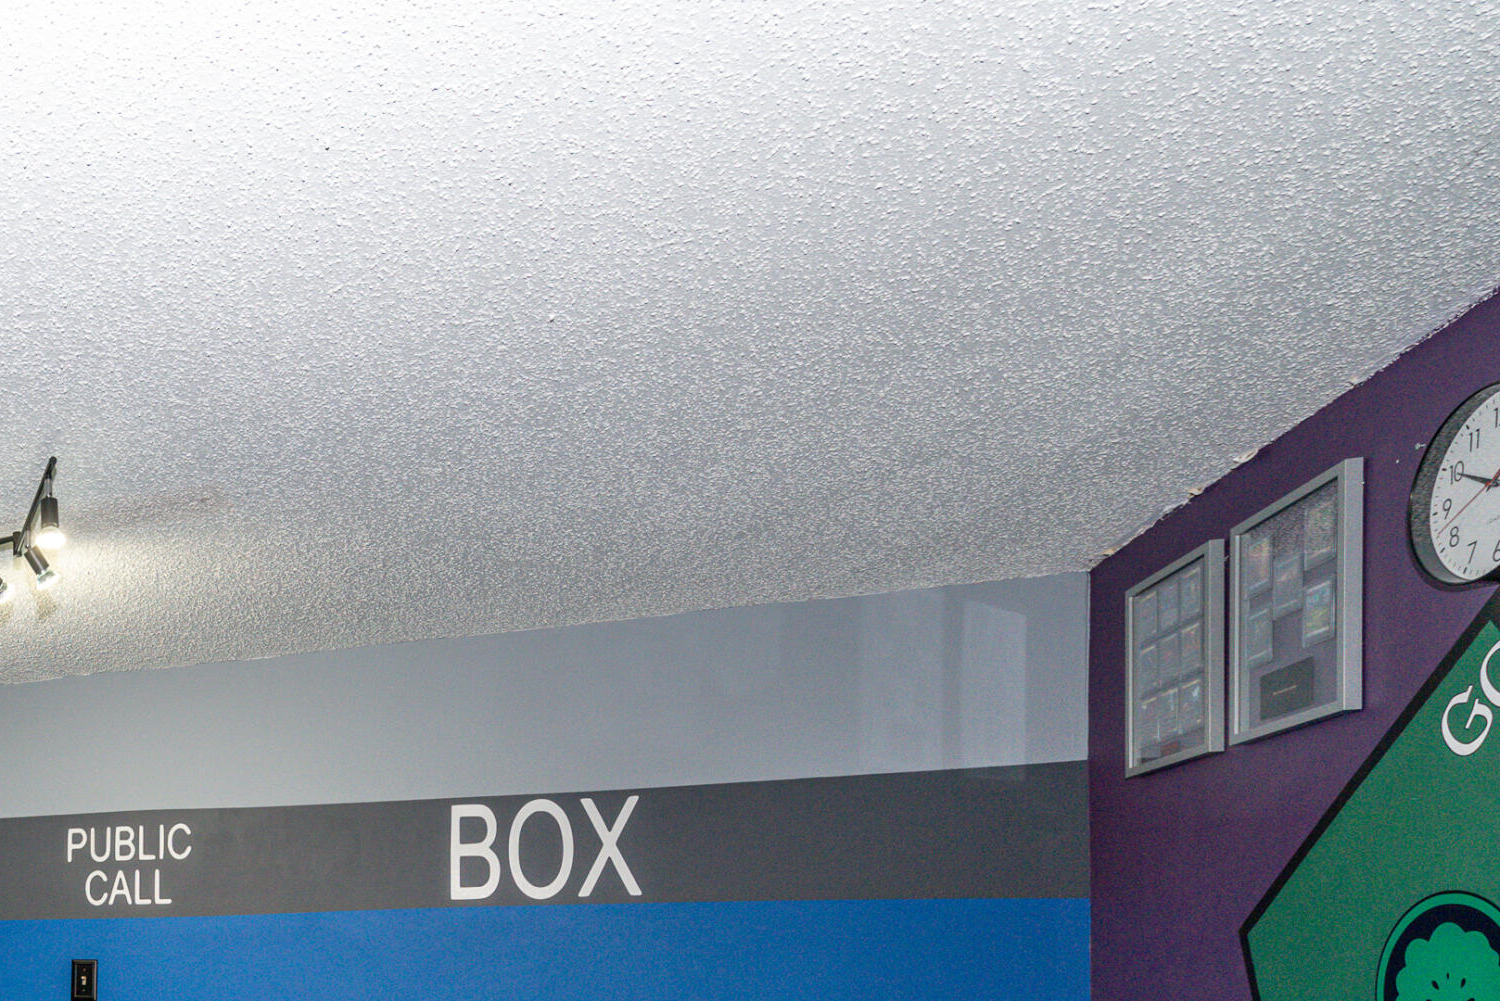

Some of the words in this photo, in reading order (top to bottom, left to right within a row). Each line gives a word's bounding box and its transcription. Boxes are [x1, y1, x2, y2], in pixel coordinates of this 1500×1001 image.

[1469, 429, 1480, 452] 11
[1448, 460, 1464, 485] 10
[1442, 498, 1452, 520] 9
[1449, 526, 1460, 547] 8
[1467, 540, 1478, 564] 7
[67, 822, 192, 863] PUBLIC
[449, 794, 642, 901] BOX
[84, 868, 172, 907] CALL
